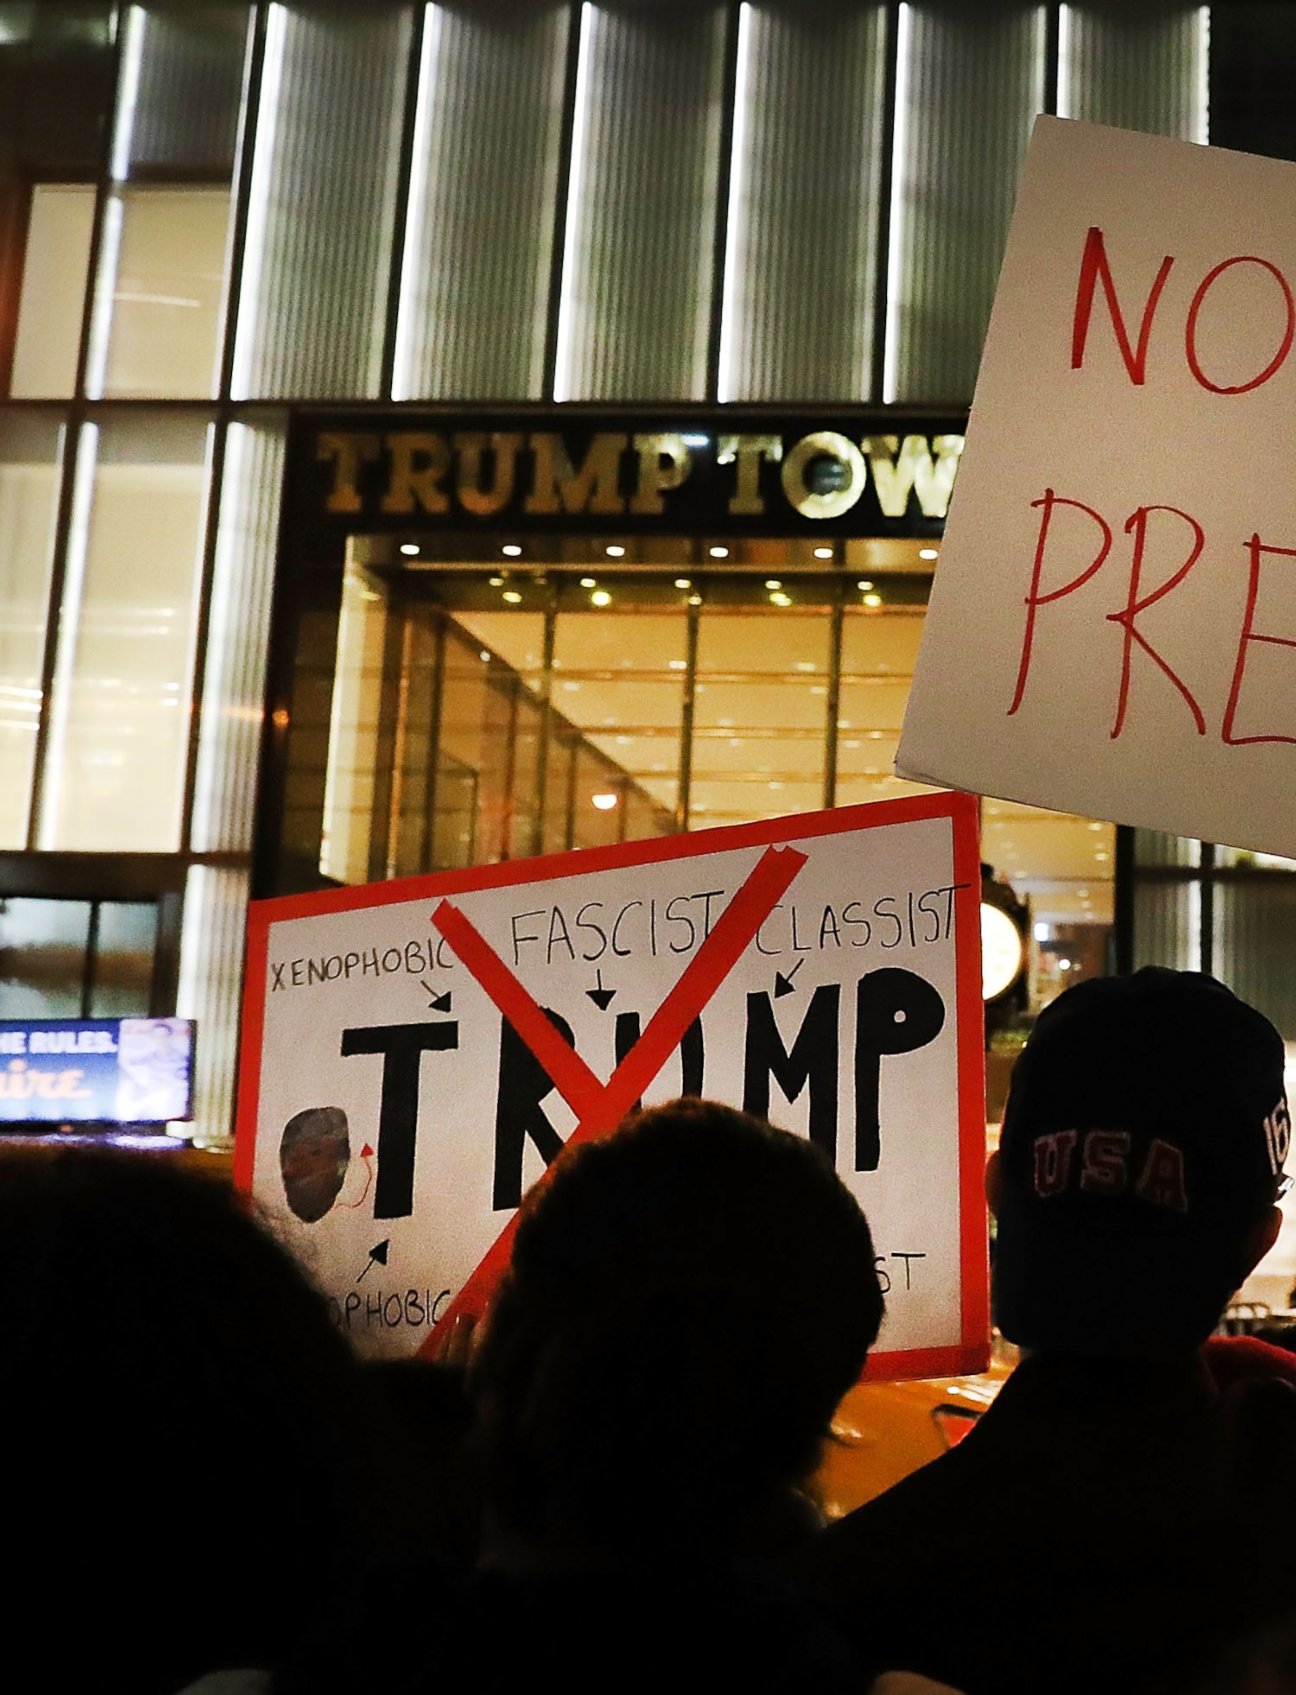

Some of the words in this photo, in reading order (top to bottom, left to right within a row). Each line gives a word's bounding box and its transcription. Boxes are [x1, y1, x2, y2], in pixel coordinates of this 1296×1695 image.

[315, 431, 692, 516] TRUMP
[511, 889, 725, 966] FASCIST
[755, 883, 972, 955] CLASSIST
[270, 936, 454, 992] XENOPHOBIC
[1033, 1128, 1188, 1214] USA
